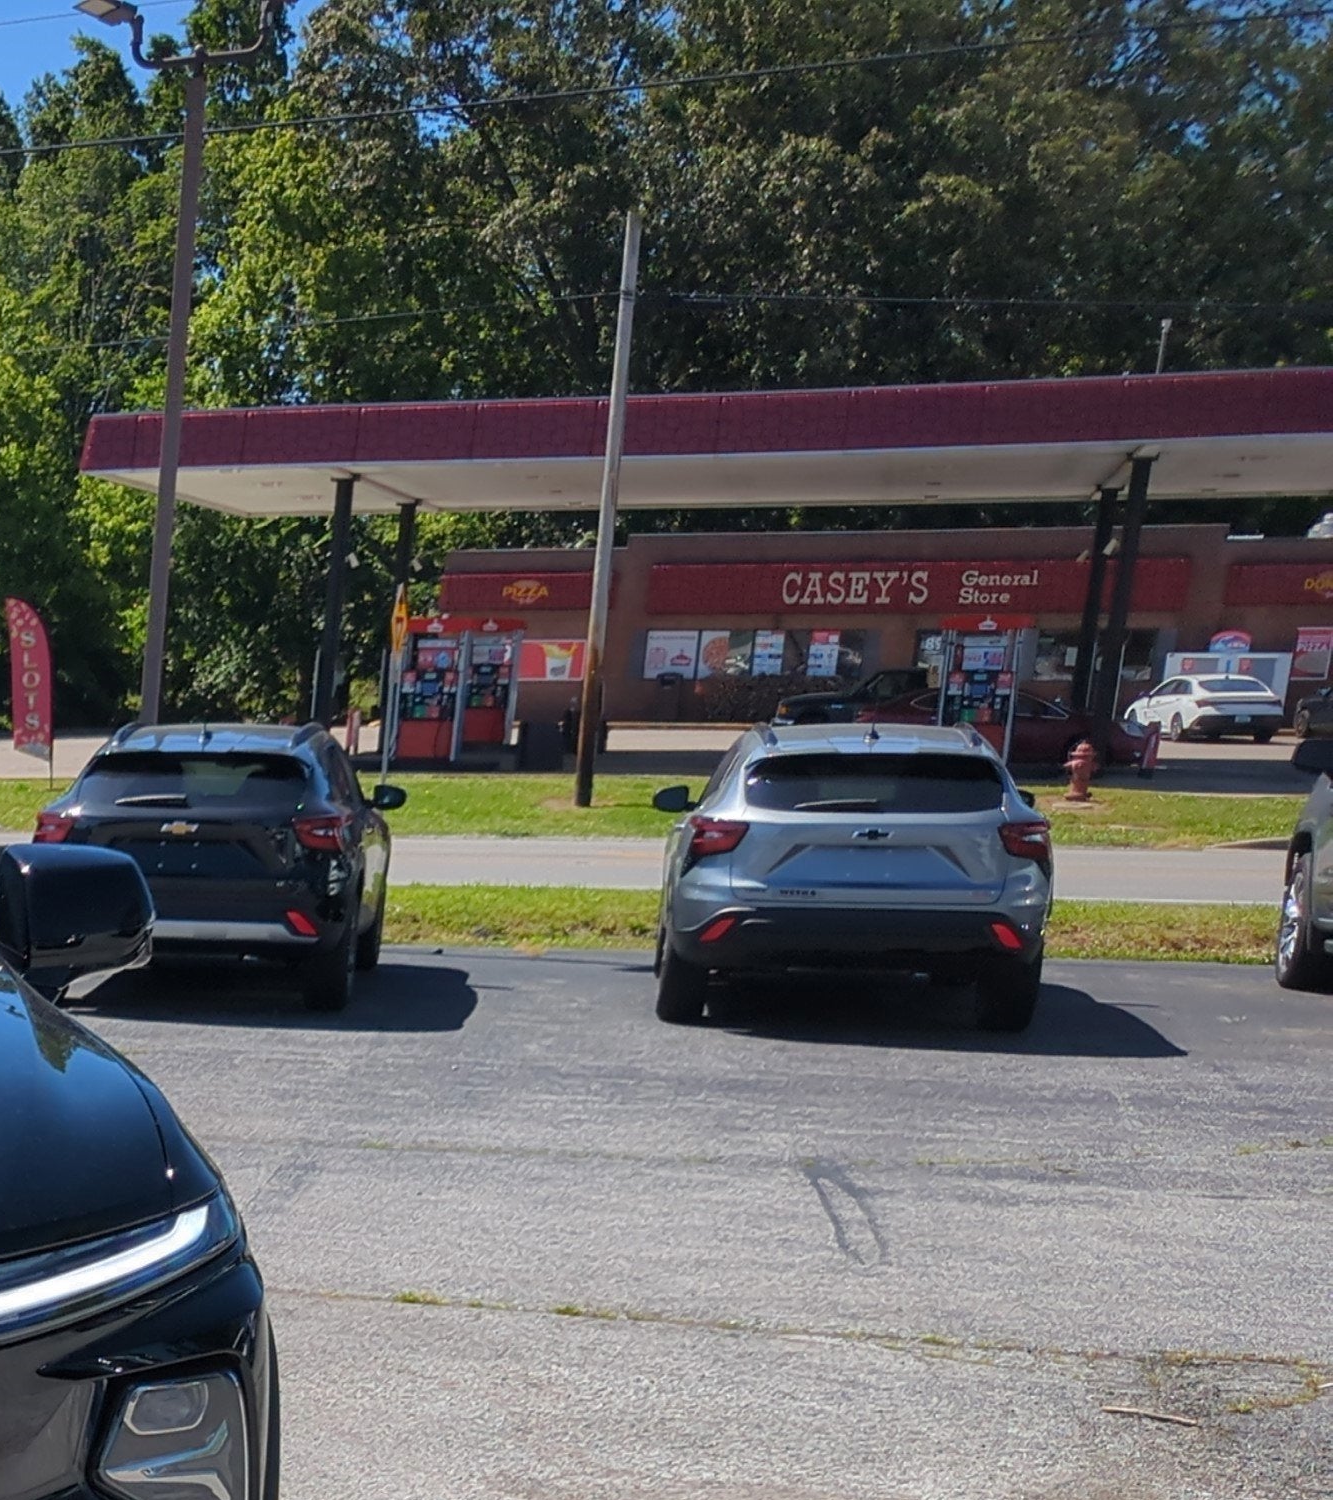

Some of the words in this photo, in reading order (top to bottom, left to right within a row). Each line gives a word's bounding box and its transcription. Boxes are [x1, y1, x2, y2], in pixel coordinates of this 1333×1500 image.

[961, 569, 1039, 587] General
[501, 585, 549, 597] PIZZA
[782, 570, 929, 605] CASEY'S
[957, 587, 1011, 605] Store
[20, 629, 42, 731] SLOTS
